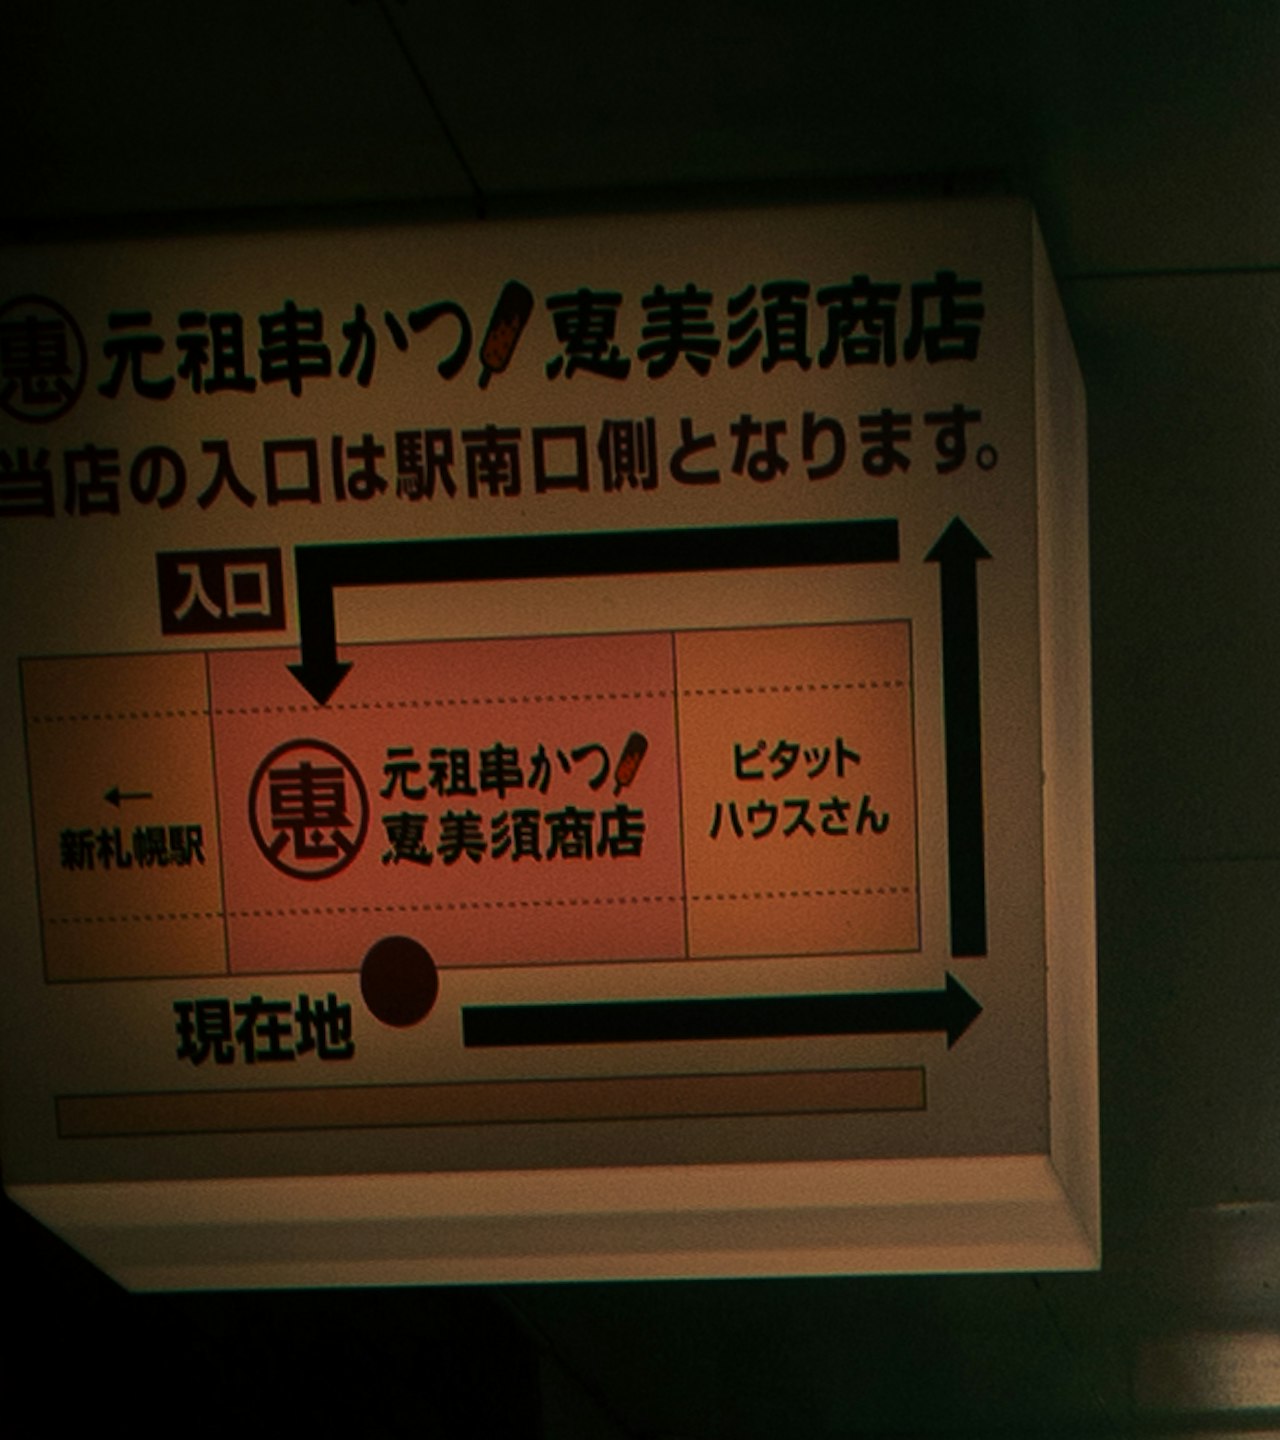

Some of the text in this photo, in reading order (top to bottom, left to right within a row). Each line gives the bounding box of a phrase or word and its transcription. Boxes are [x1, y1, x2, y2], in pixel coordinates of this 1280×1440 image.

[99, 299, 472, 399] 元祖串かつ
[0, 403, 998, 517] 当店の入口は駅南口側となります。
[172, 562, 272, 621] 入口
[379, 742, 610, 799] 元祖串かつ
[733, 737, 861, 781] ピタット
[709, 796, 890, 840] ハウスさん
[59, 824, 205, 871] 新札幌駅
[173, 993, 355, 1066] 現在地
